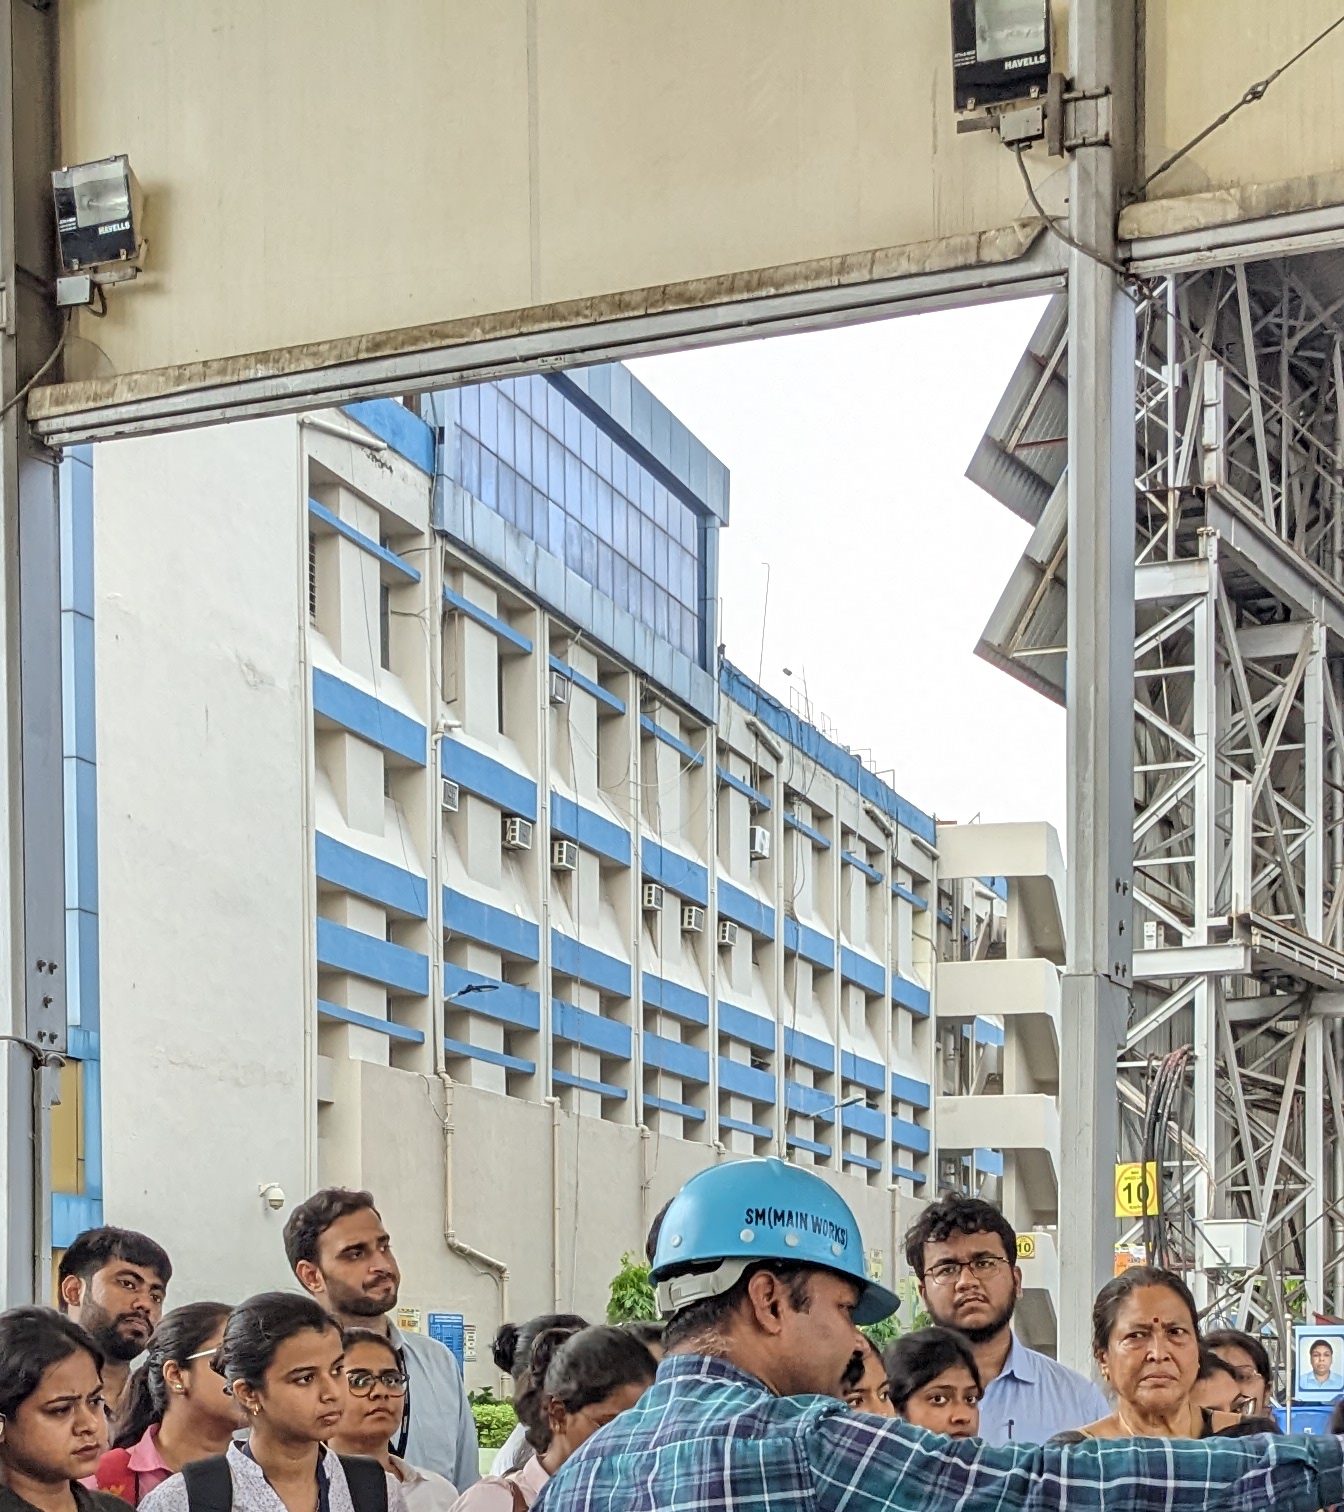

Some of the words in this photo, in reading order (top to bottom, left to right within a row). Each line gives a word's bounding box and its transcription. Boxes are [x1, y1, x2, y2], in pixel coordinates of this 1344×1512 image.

[1004, 53, 1047, 71] HAVELLS
[1122, 1182, 1150, 1205] 10
[744, 1206, 809, 1231] SM(MAIN
[811, 1214, 848, 1251] WORKS)
[1017, 1242, 1031, 1253] 10
